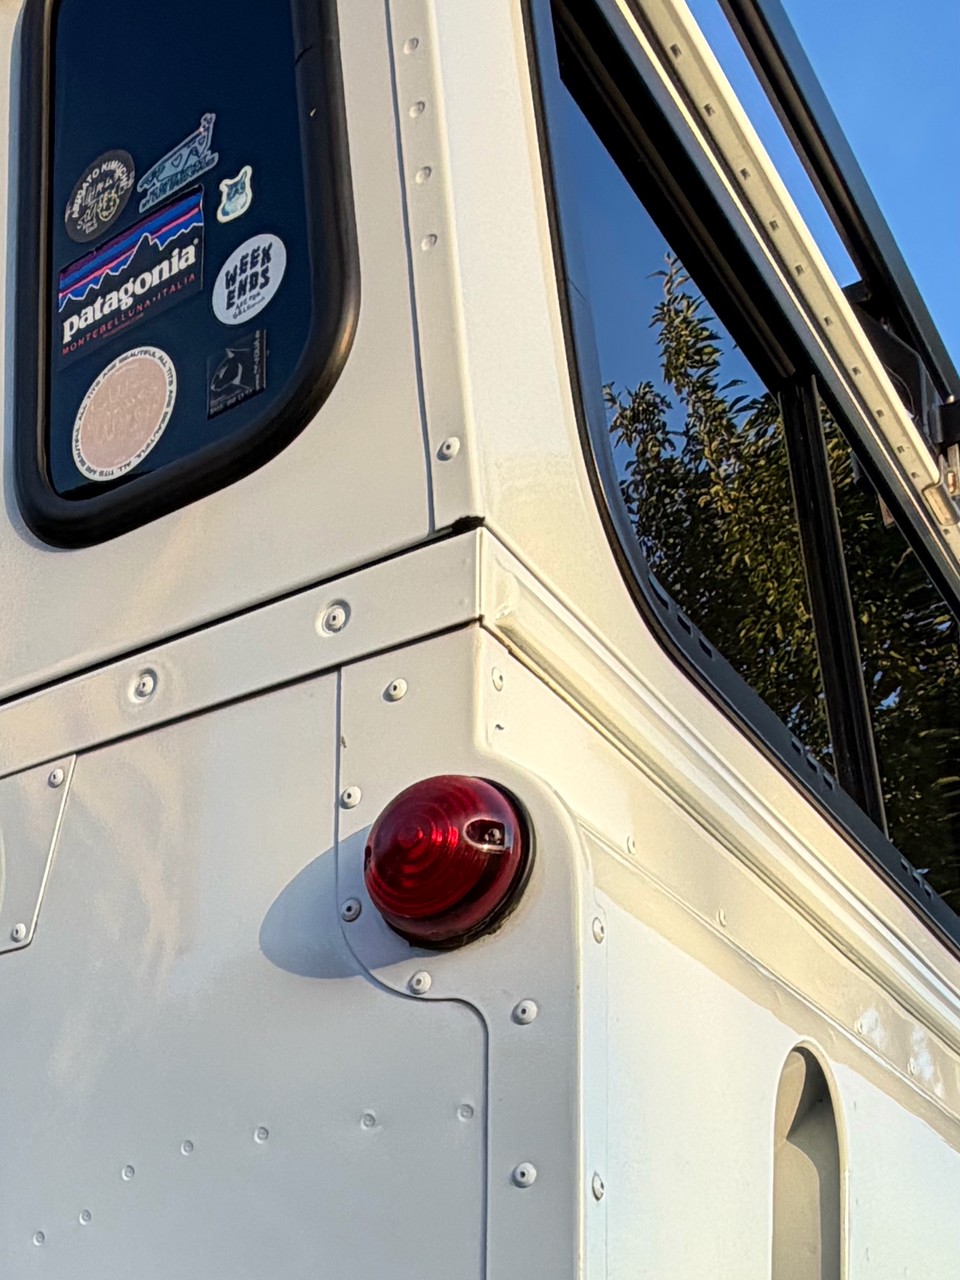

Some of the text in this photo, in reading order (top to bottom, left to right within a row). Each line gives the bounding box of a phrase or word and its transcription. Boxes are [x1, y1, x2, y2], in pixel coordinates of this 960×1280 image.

[225, 242, 273, 290] WEEK
[226, 265, 270, 311] ENDS
[63, 245, 196, 345] patagonia
